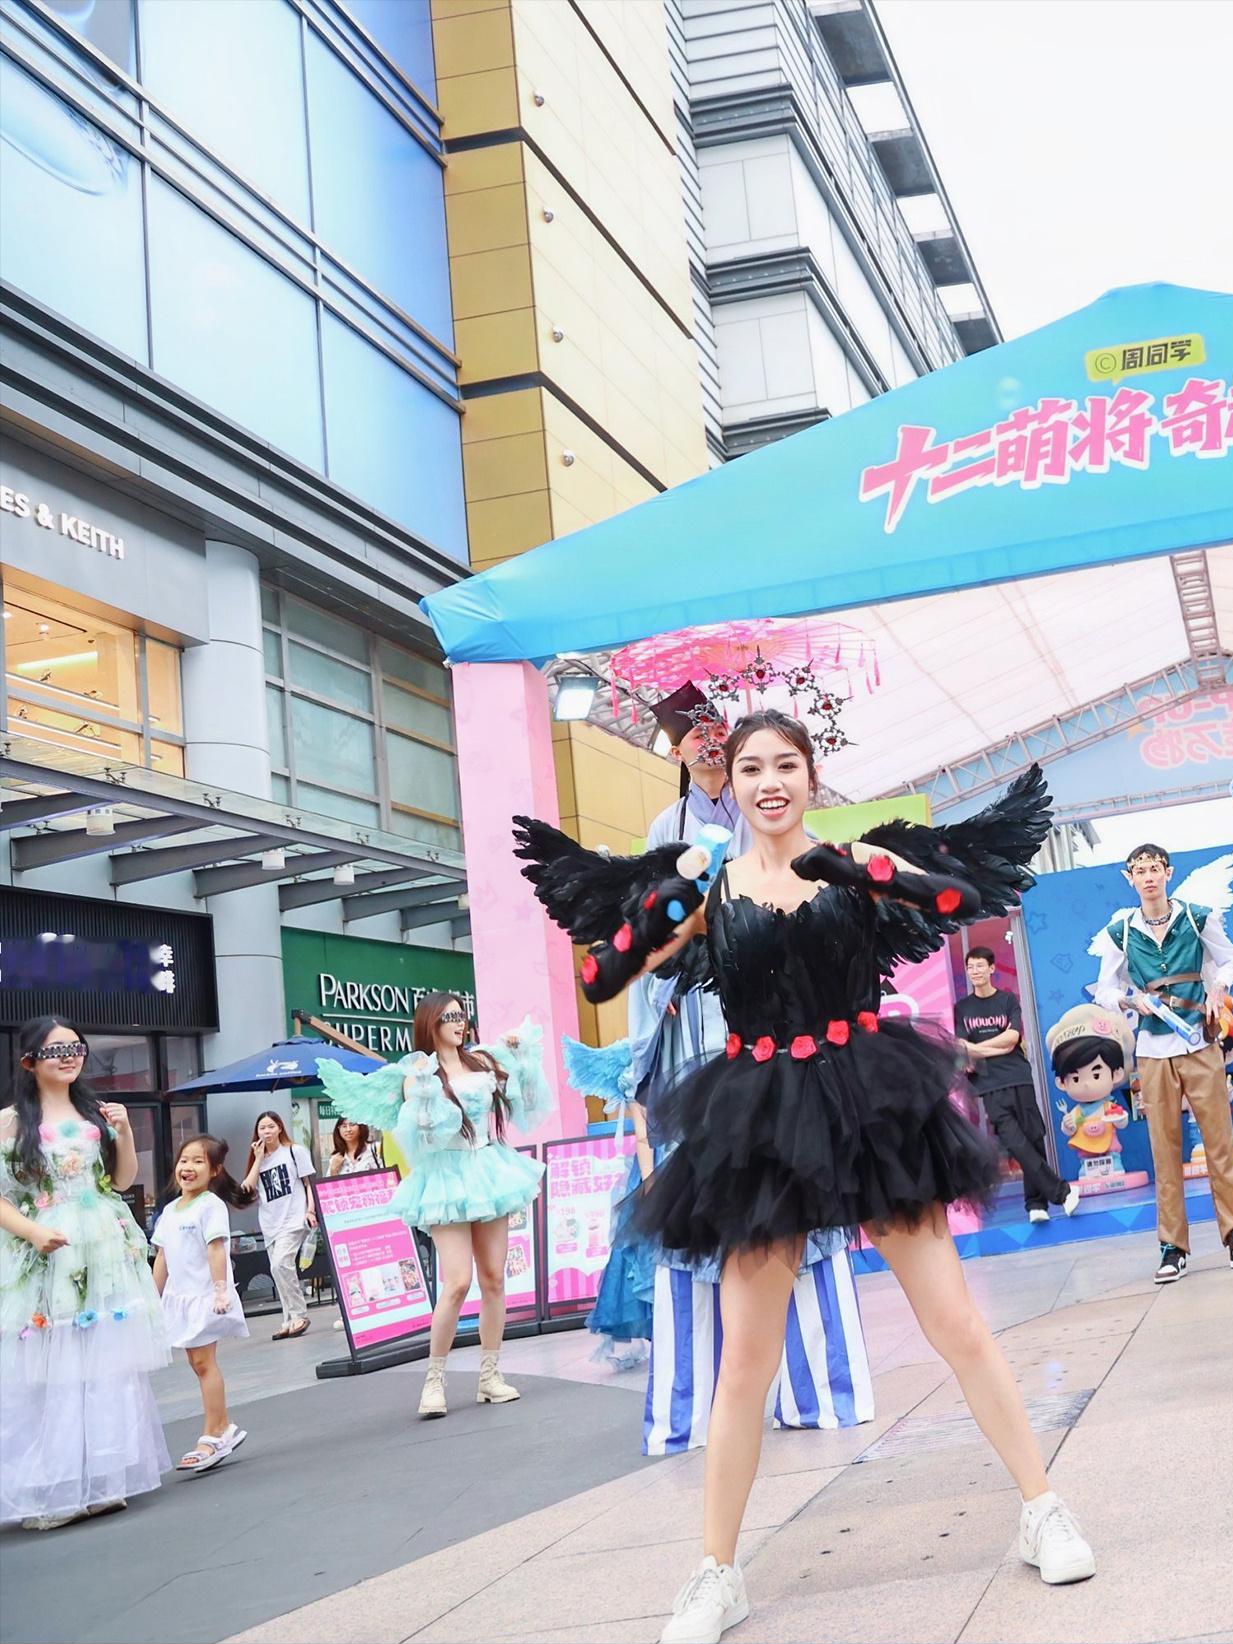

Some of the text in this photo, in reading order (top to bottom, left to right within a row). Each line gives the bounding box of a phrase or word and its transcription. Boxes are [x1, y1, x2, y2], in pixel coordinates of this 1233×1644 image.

[859, 387, 1154, 533] 十二萌将
[36, 503, 55, 529] &
[60, 511, 125, 560] KEITH
[320, 973, 410, 1014] PARKSON
